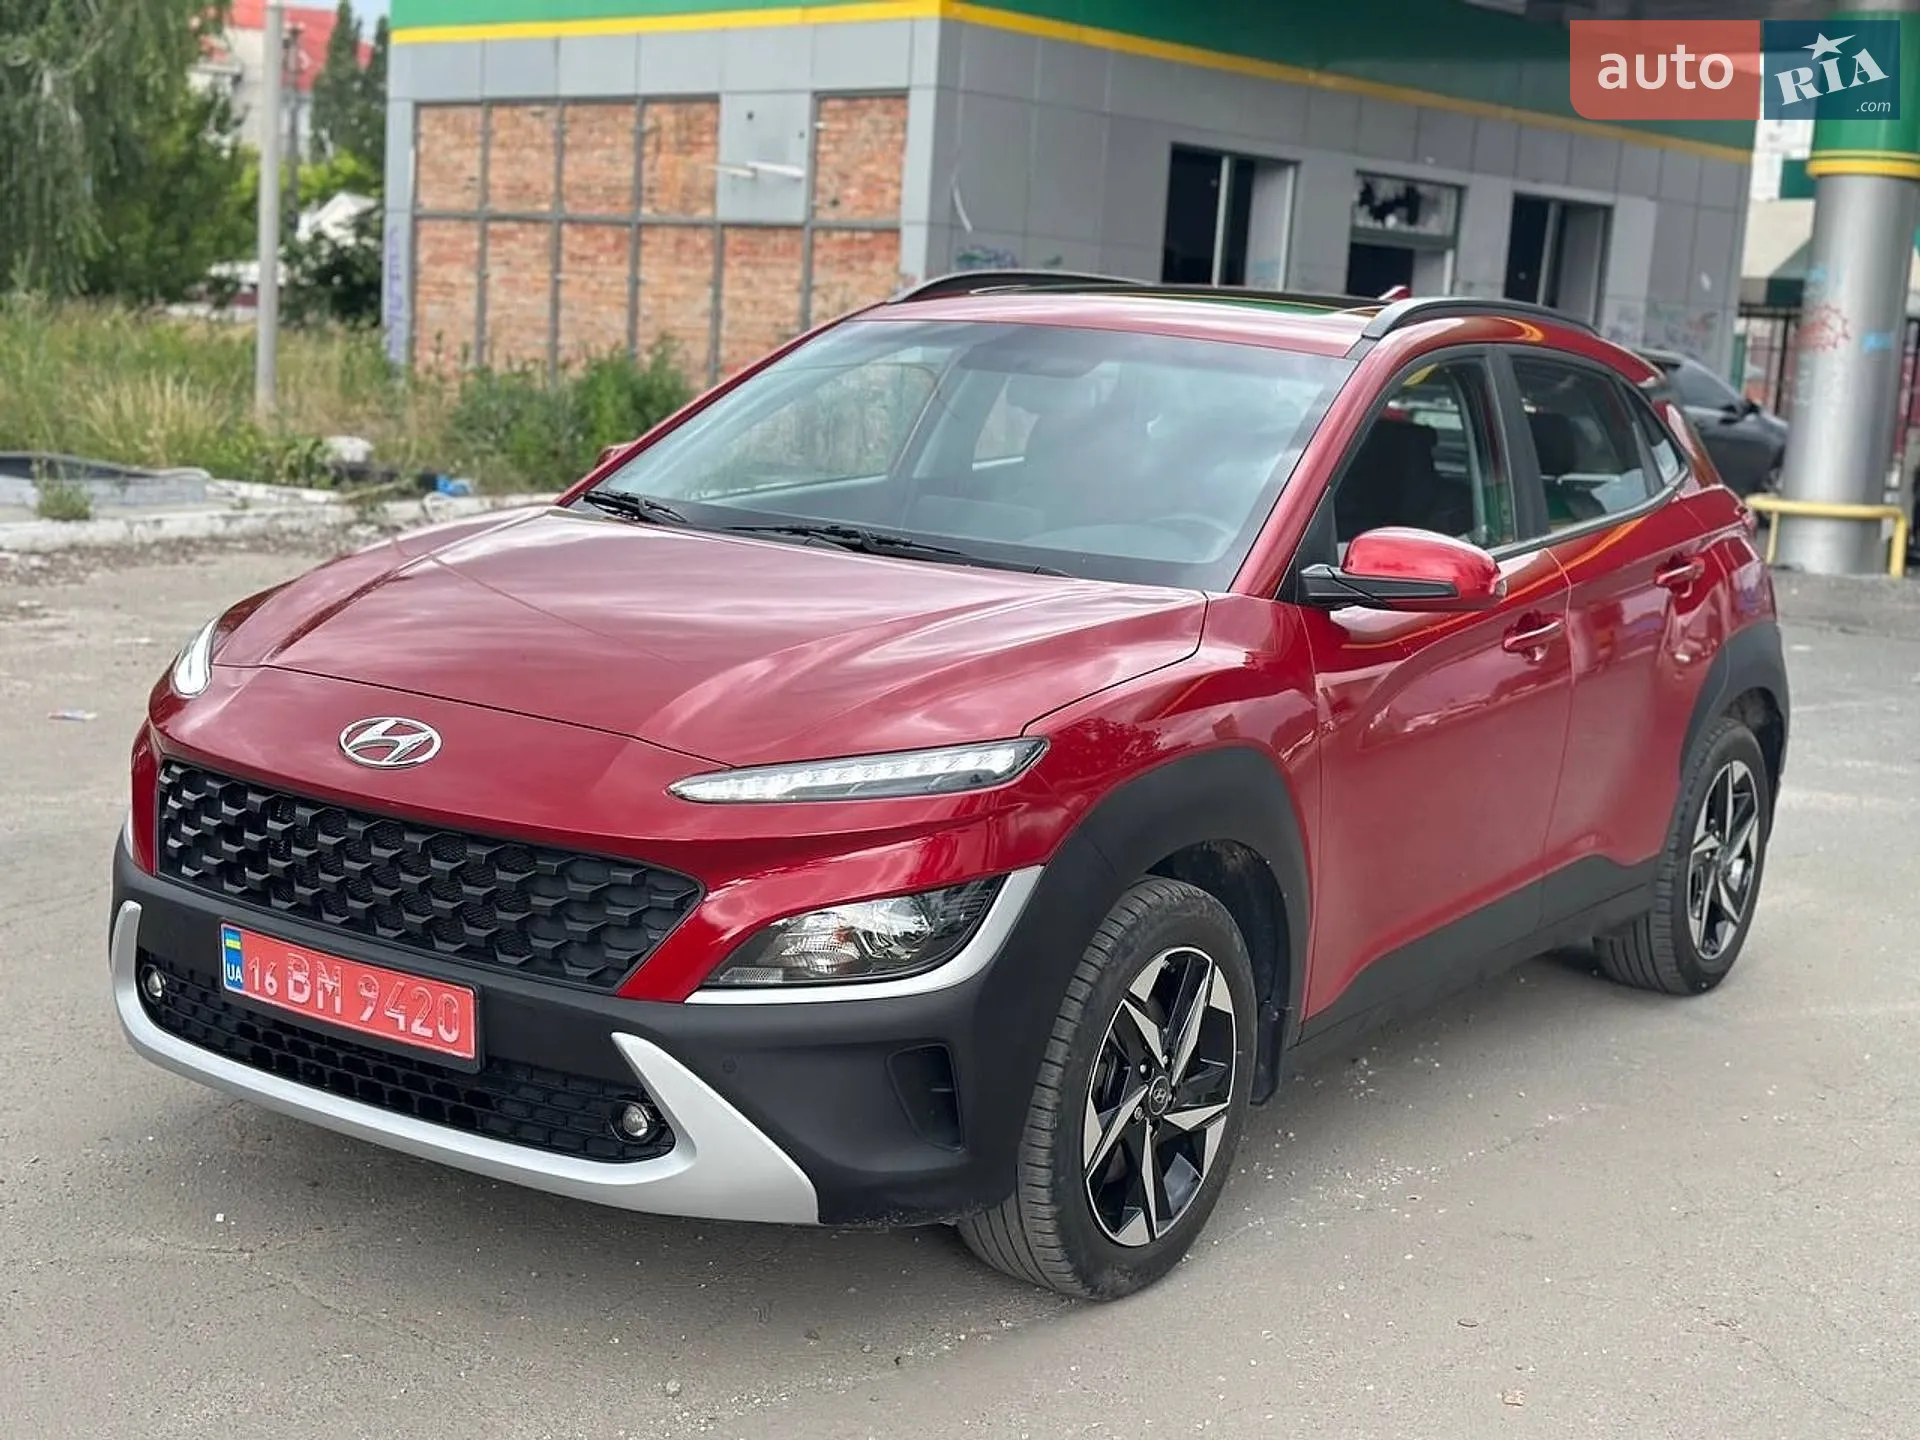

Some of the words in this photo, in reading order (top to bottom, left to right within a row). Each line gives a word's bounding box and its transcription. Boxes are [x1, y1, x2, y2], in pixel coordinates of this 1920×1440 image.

[226, 963, 243, 983] UA
[248, 956, 278, 995] 16
[287, 953, 343, 1014] BM
[358, 974, 460, 1042] 9420
